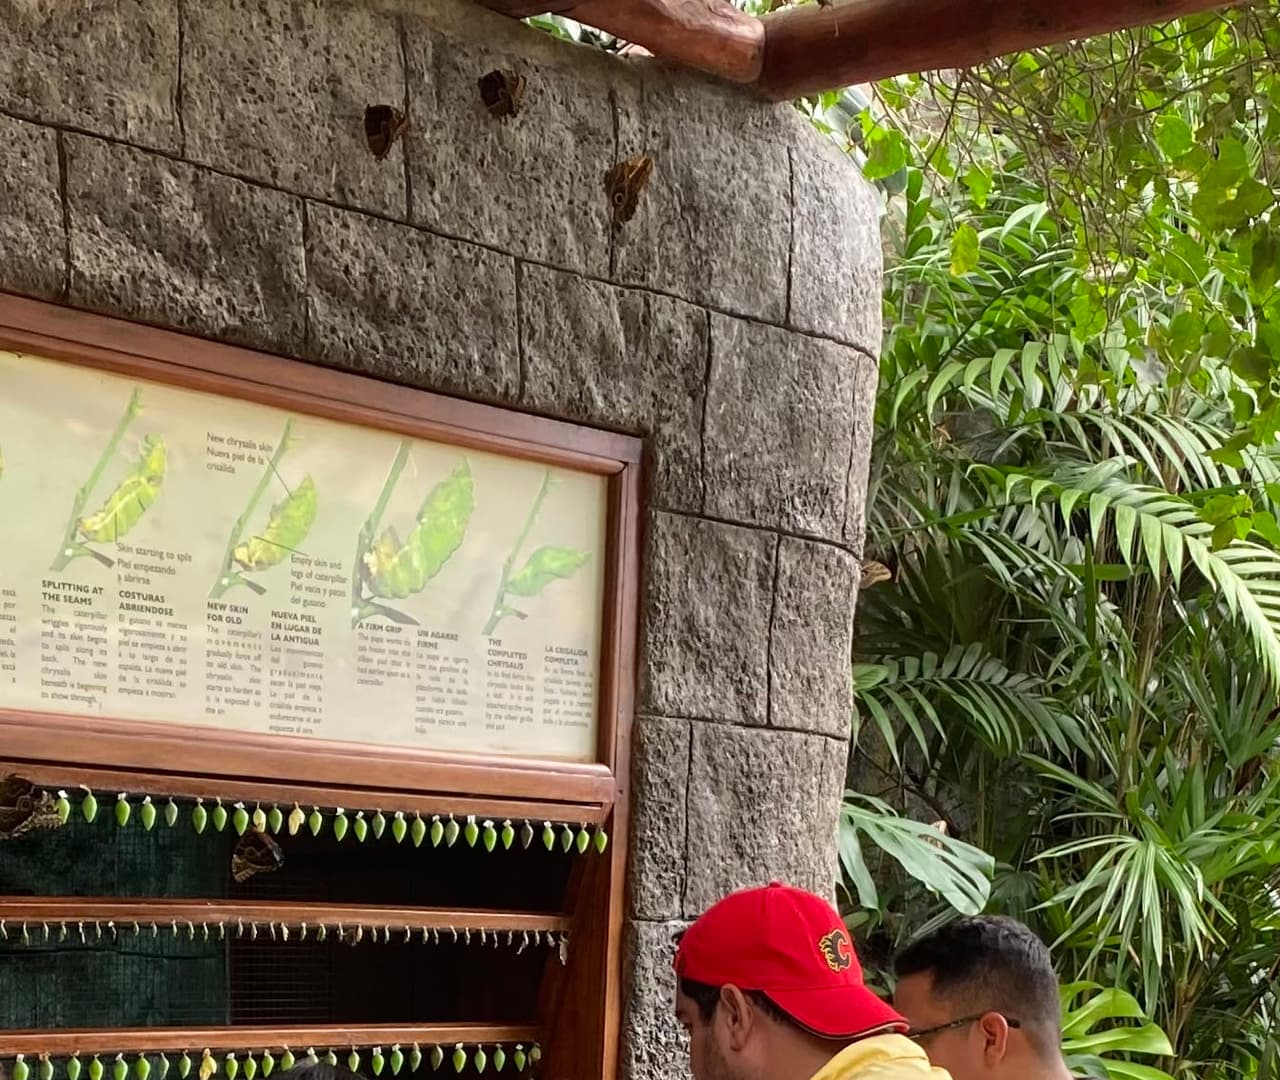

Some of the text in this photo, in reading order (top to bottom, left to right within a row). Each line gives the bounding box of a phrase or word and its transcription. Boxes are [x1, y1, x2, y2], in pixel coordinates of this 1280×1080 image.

[42, 580, 104, 595] SPLITTING AT
[42, 592, 92, 606] THE SEAMS
[119, 590, 165, 603] COSTURAS
[119, 602, 173, 616] ABRIENDOSE
[207, 601, 248, 614] NEW SKIN
[207, 613, 242, 625] FOR OLD
[271, 610, 316, 623] NUEVA PIEL
[271, 621, 322, 635] EN LUGAR DE
[271, 633, 319, 646] LA ANTIGUA
